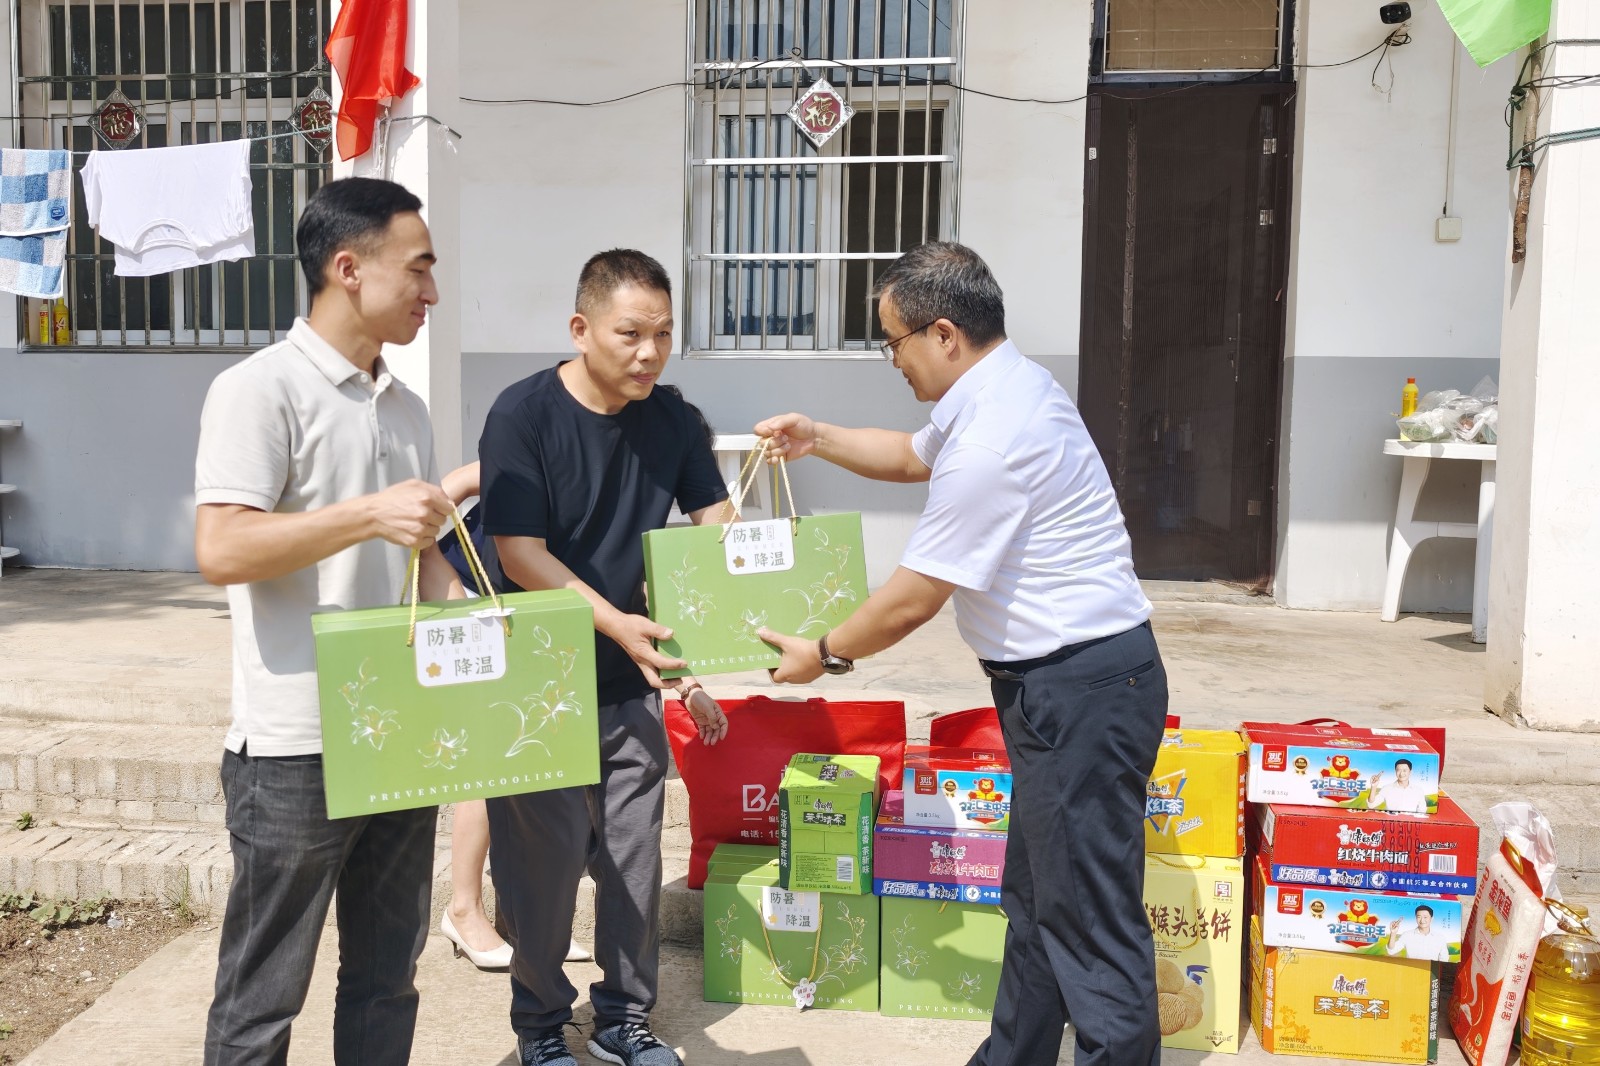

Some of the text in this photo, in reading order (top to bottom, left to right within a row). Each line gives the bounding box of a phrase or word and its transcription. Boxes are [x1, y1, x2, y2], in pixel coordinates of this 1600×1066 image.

[103, 105, 133, 136] 福
[804, 95, 837, 128] 福
[733, 526, 763, 544] 防暑
[754, 551, 786, 568] 降温
[427, 625, 467, 647] 防暑
[454, 656, 495, 677] 降温
[369, 770, 565, 803] PREVENTIONCOOLING
[1310, 777, 1367, 791] 双汇王中王
[861, 815, 870, 874] 花清香 茶新味
[1337, 847, 1409, 864] 红烧牛肉面
[1277, 865, 1319, 883] 好品质
[770, 892, 796, 905] 防暑
[1488, 879, 1513, 922] 金龙鱼
[785, 914, 812, 928] 降温
[1327, 922, 1386, 936] 双汇王中王
[1501, 951, 1530, 1022] 金龙鱼 稻花香
[1315, 997, 1388, 1020] 茉莉蜜茶
[1429, 1010, 1438, 1041] 茶新味
